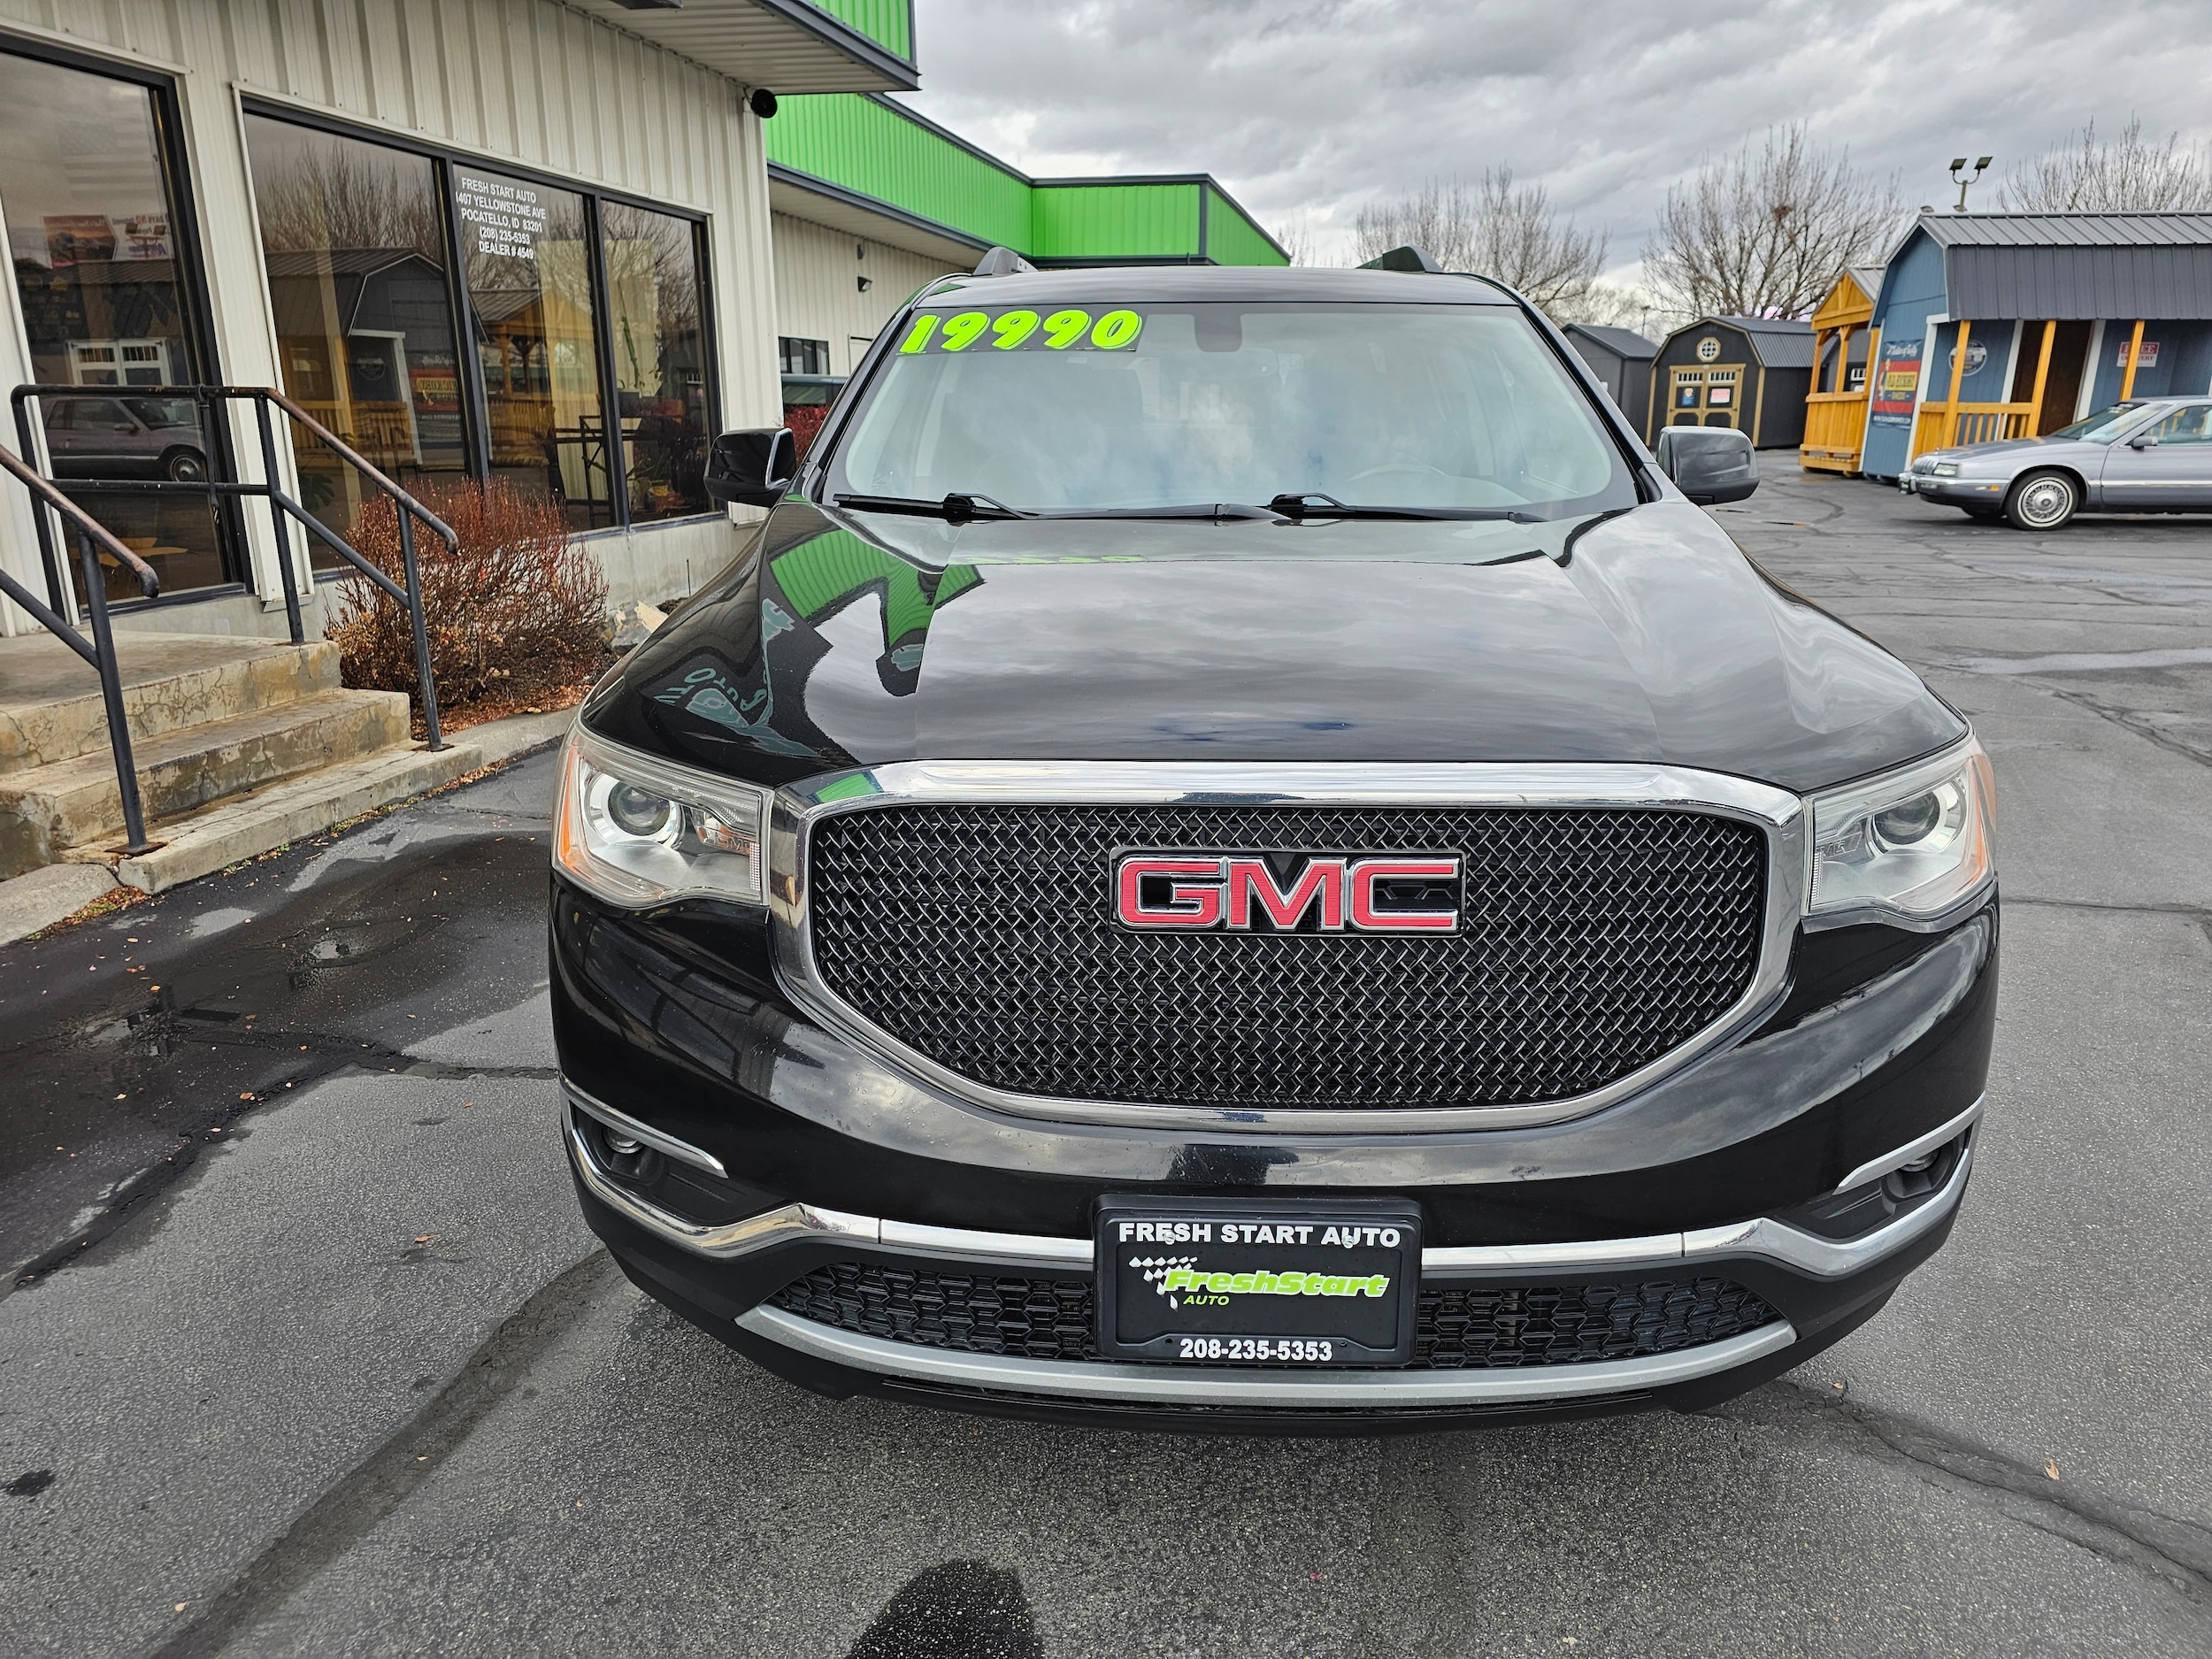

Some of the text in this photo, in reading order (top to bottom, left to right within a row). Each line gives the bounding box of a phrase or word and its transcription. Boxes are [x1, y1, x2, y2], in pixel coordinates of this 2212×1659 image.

[461, 177, 537, 204] FRESH START AUTO
[455, 191, 547, 220] 1407 YELLOWSTONE AVE
[461, 208, 543, 233] POCATELLO, ID 83201
[479, 226, 531, 245] (208) 235-5353
[479, 240, 534, 260] DEALER # 4549
[899, 310, 1143, 354] 19990
[1118, 856, 1459, 931] GMC
[1118, 1223, 1401, 1248] FRESH START AUTO
[1164, 1270, 1390, 1298] FreshStart
[1183, 1294, 1230, 1306] AUTO
[1179, 1338, 1333, 1362] 208-235-5353
